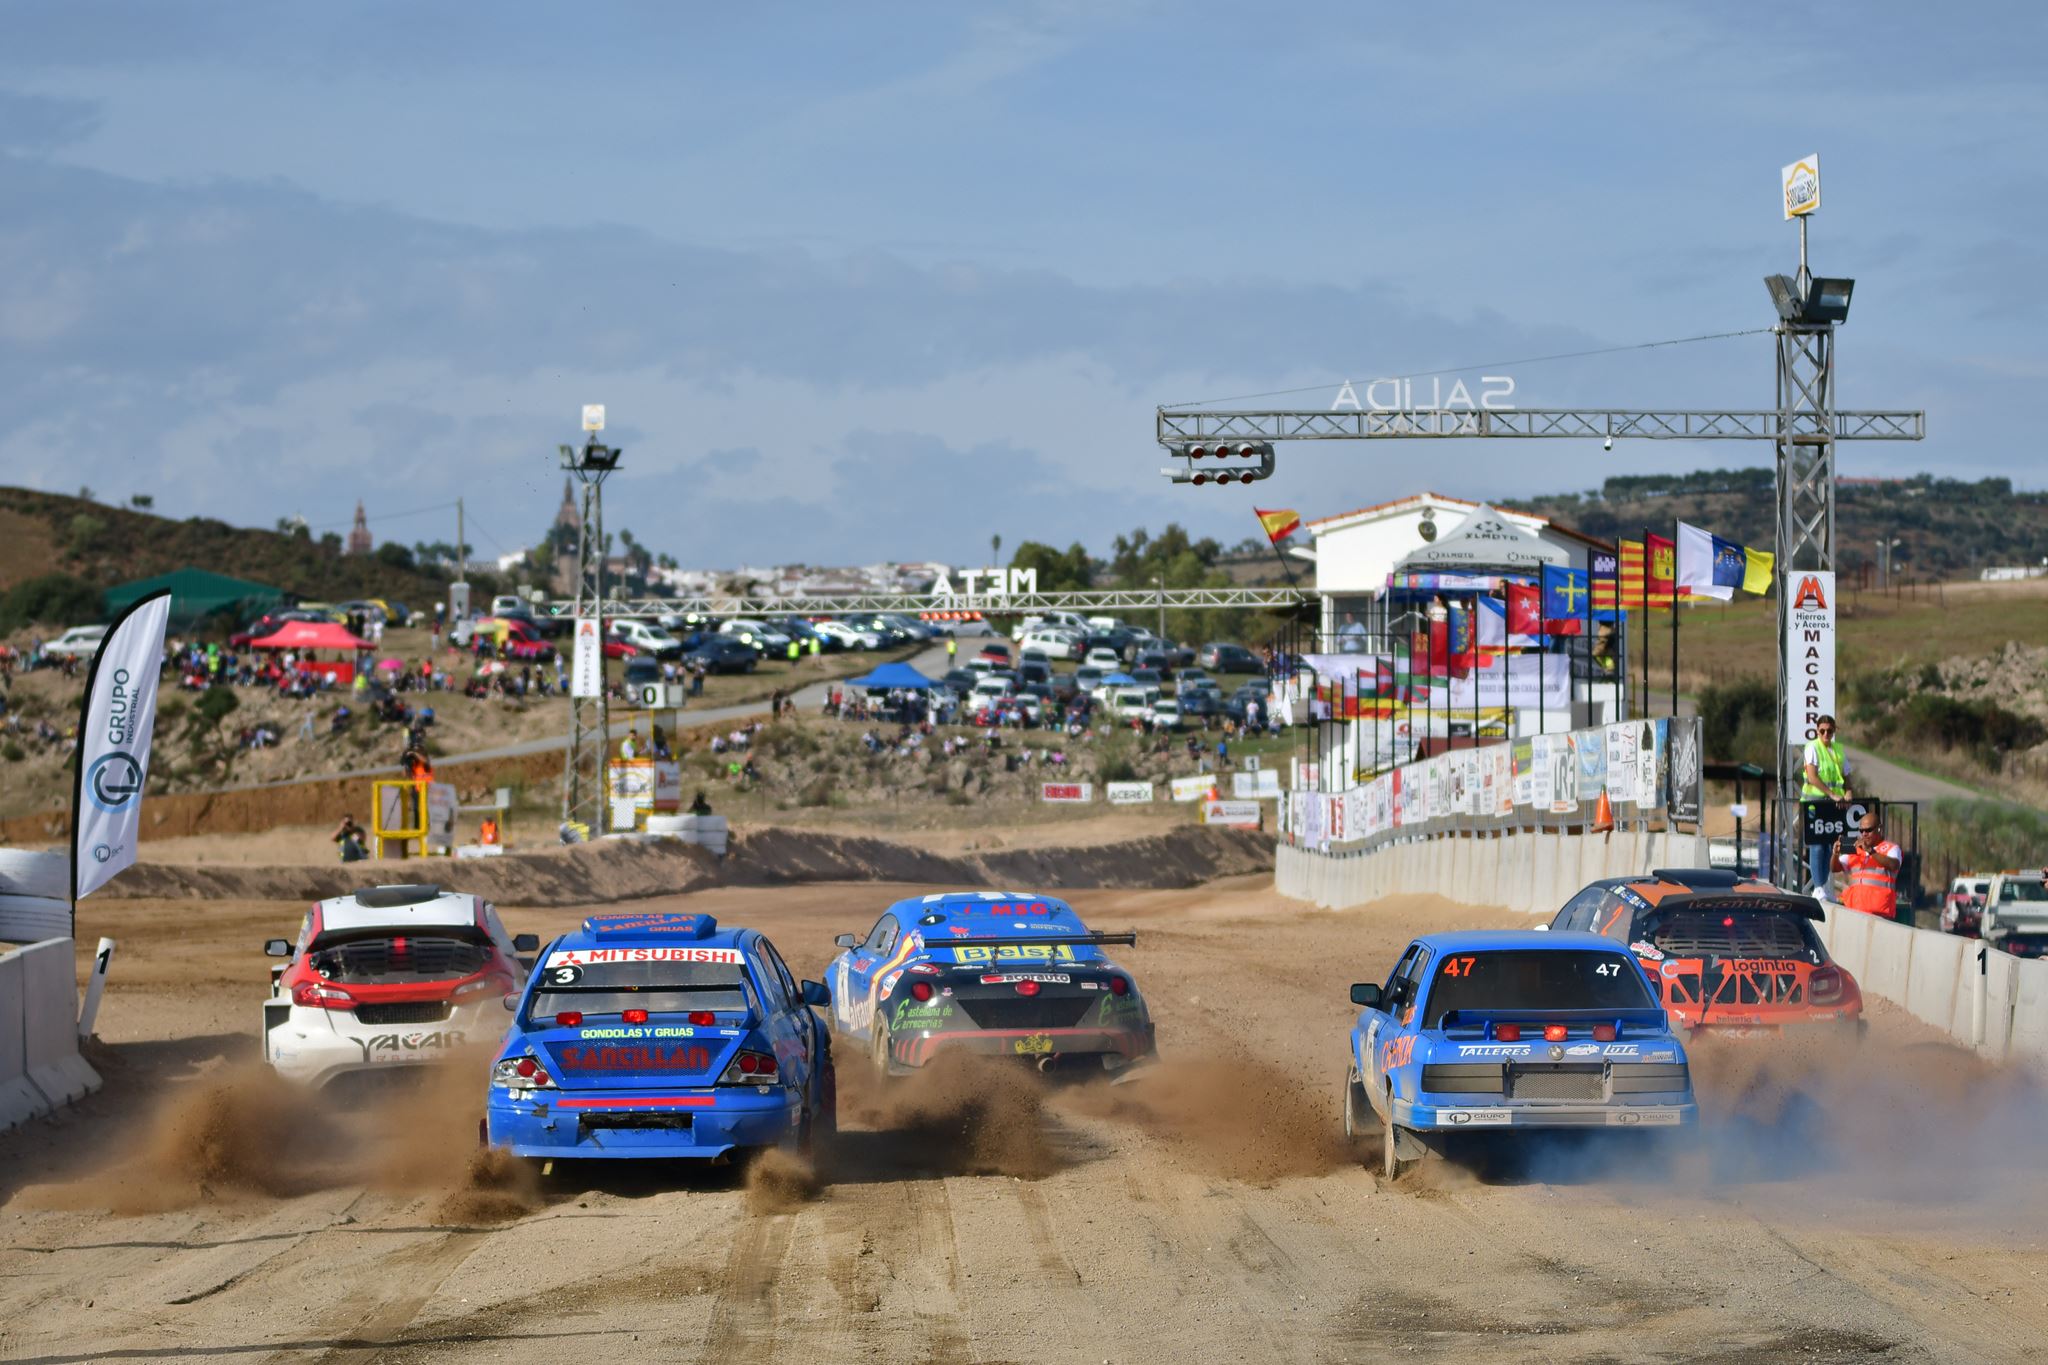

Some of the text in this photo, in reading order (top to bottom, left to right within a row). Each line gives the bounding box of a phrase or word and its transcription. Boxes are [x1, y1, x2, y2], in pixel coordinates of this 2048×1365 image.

[1796, 613, 1826, 621] Hierros
[1802, 621, 1830, 629] Aceros
[1804, 630, 1821, 741] MACARRO
[109, 669, 130, 745] GRUPO
[126, 688, 140, 744] INDUSTRIAL
[98, 948, 112, 975] 1
[589, 949, 736, 964] MITSUBISHI
[1809, 949, 1820, 964] 2
[1977, 948, 1987, 976] 1
[1444, 957, 1476, 977] 47
[1595, 963, 1621, 977] 47
[1731, 958, 1796, 974] logintia
[555, 968, 575, 984] 3
[581, 1029, 642, 1039] GONDOLAS
[655, 1028, 694, 1037] GRUAS
[1458, 1045, 1531, 1057] TALLERES
